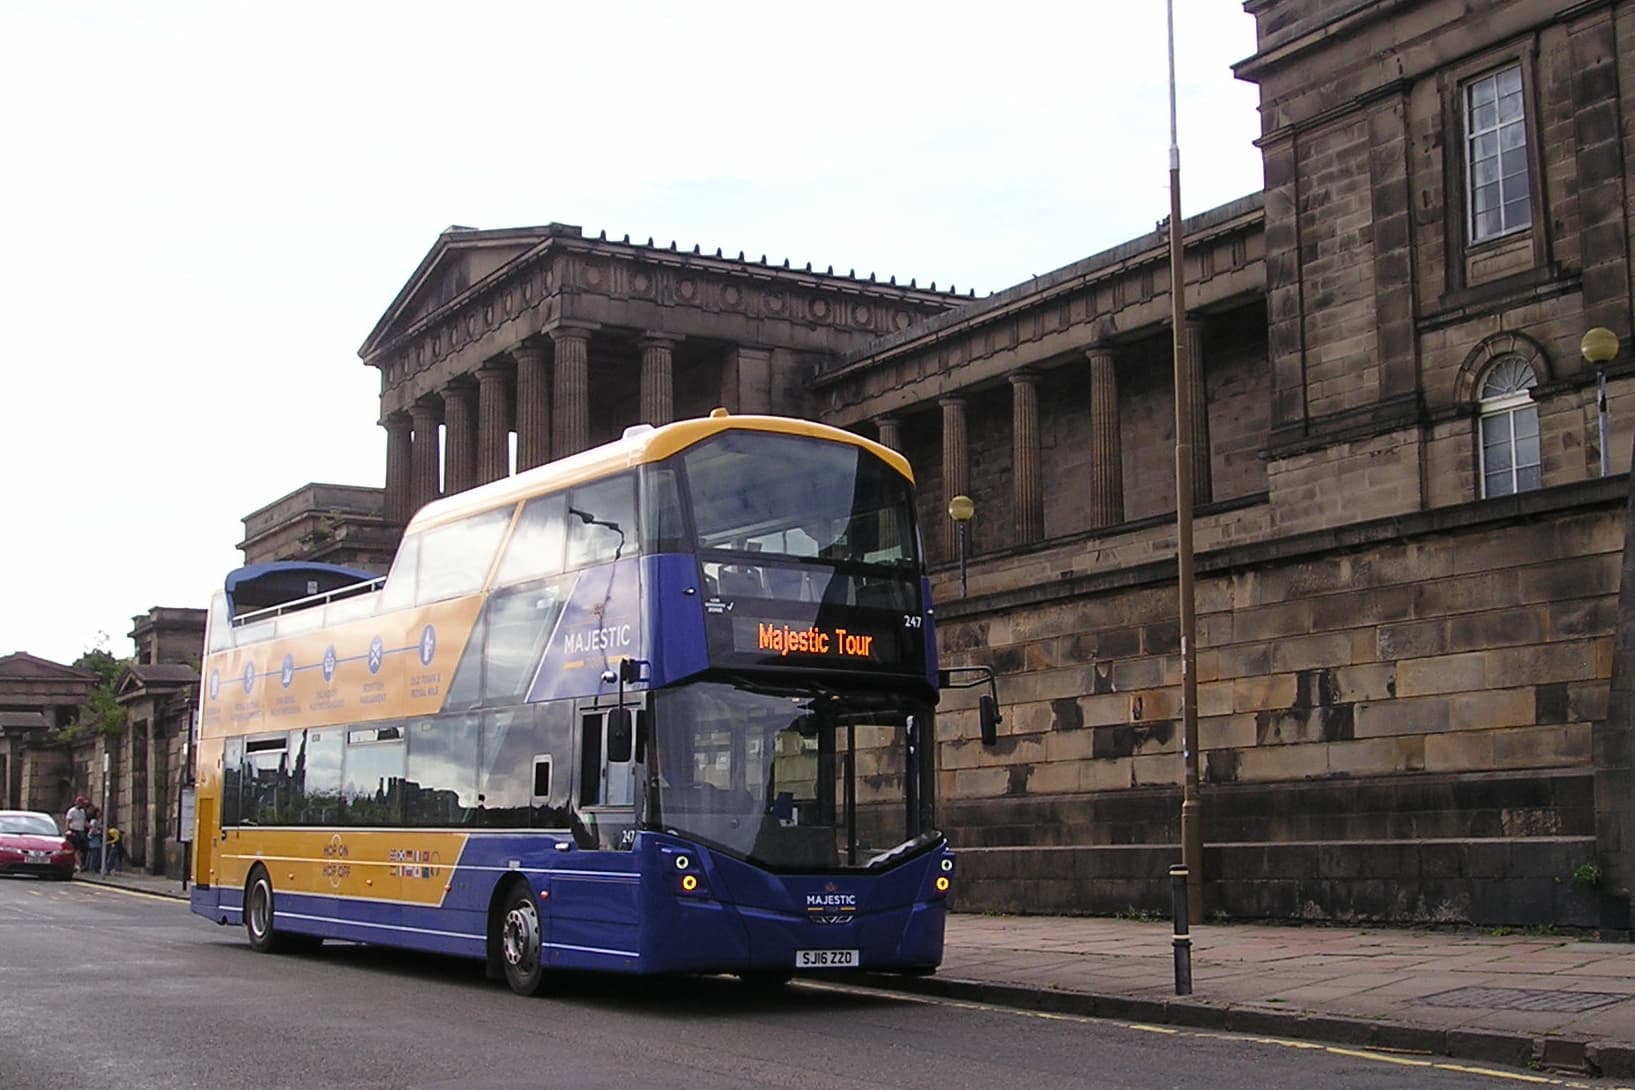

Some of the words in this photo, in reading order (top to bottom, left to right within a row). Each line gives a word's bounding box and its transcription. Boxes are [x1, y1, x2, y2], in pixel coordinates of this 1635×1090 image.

[904, 614, 922, 628] 247
[563, 623, 631, 655] MAJESTIC
[758, 622, 829, 657] Majestic
[835, 628, 873, 657] Tour
[806, 895, 856, 905] MAJESTIC
[802, 951, 828, 965] SJ16
